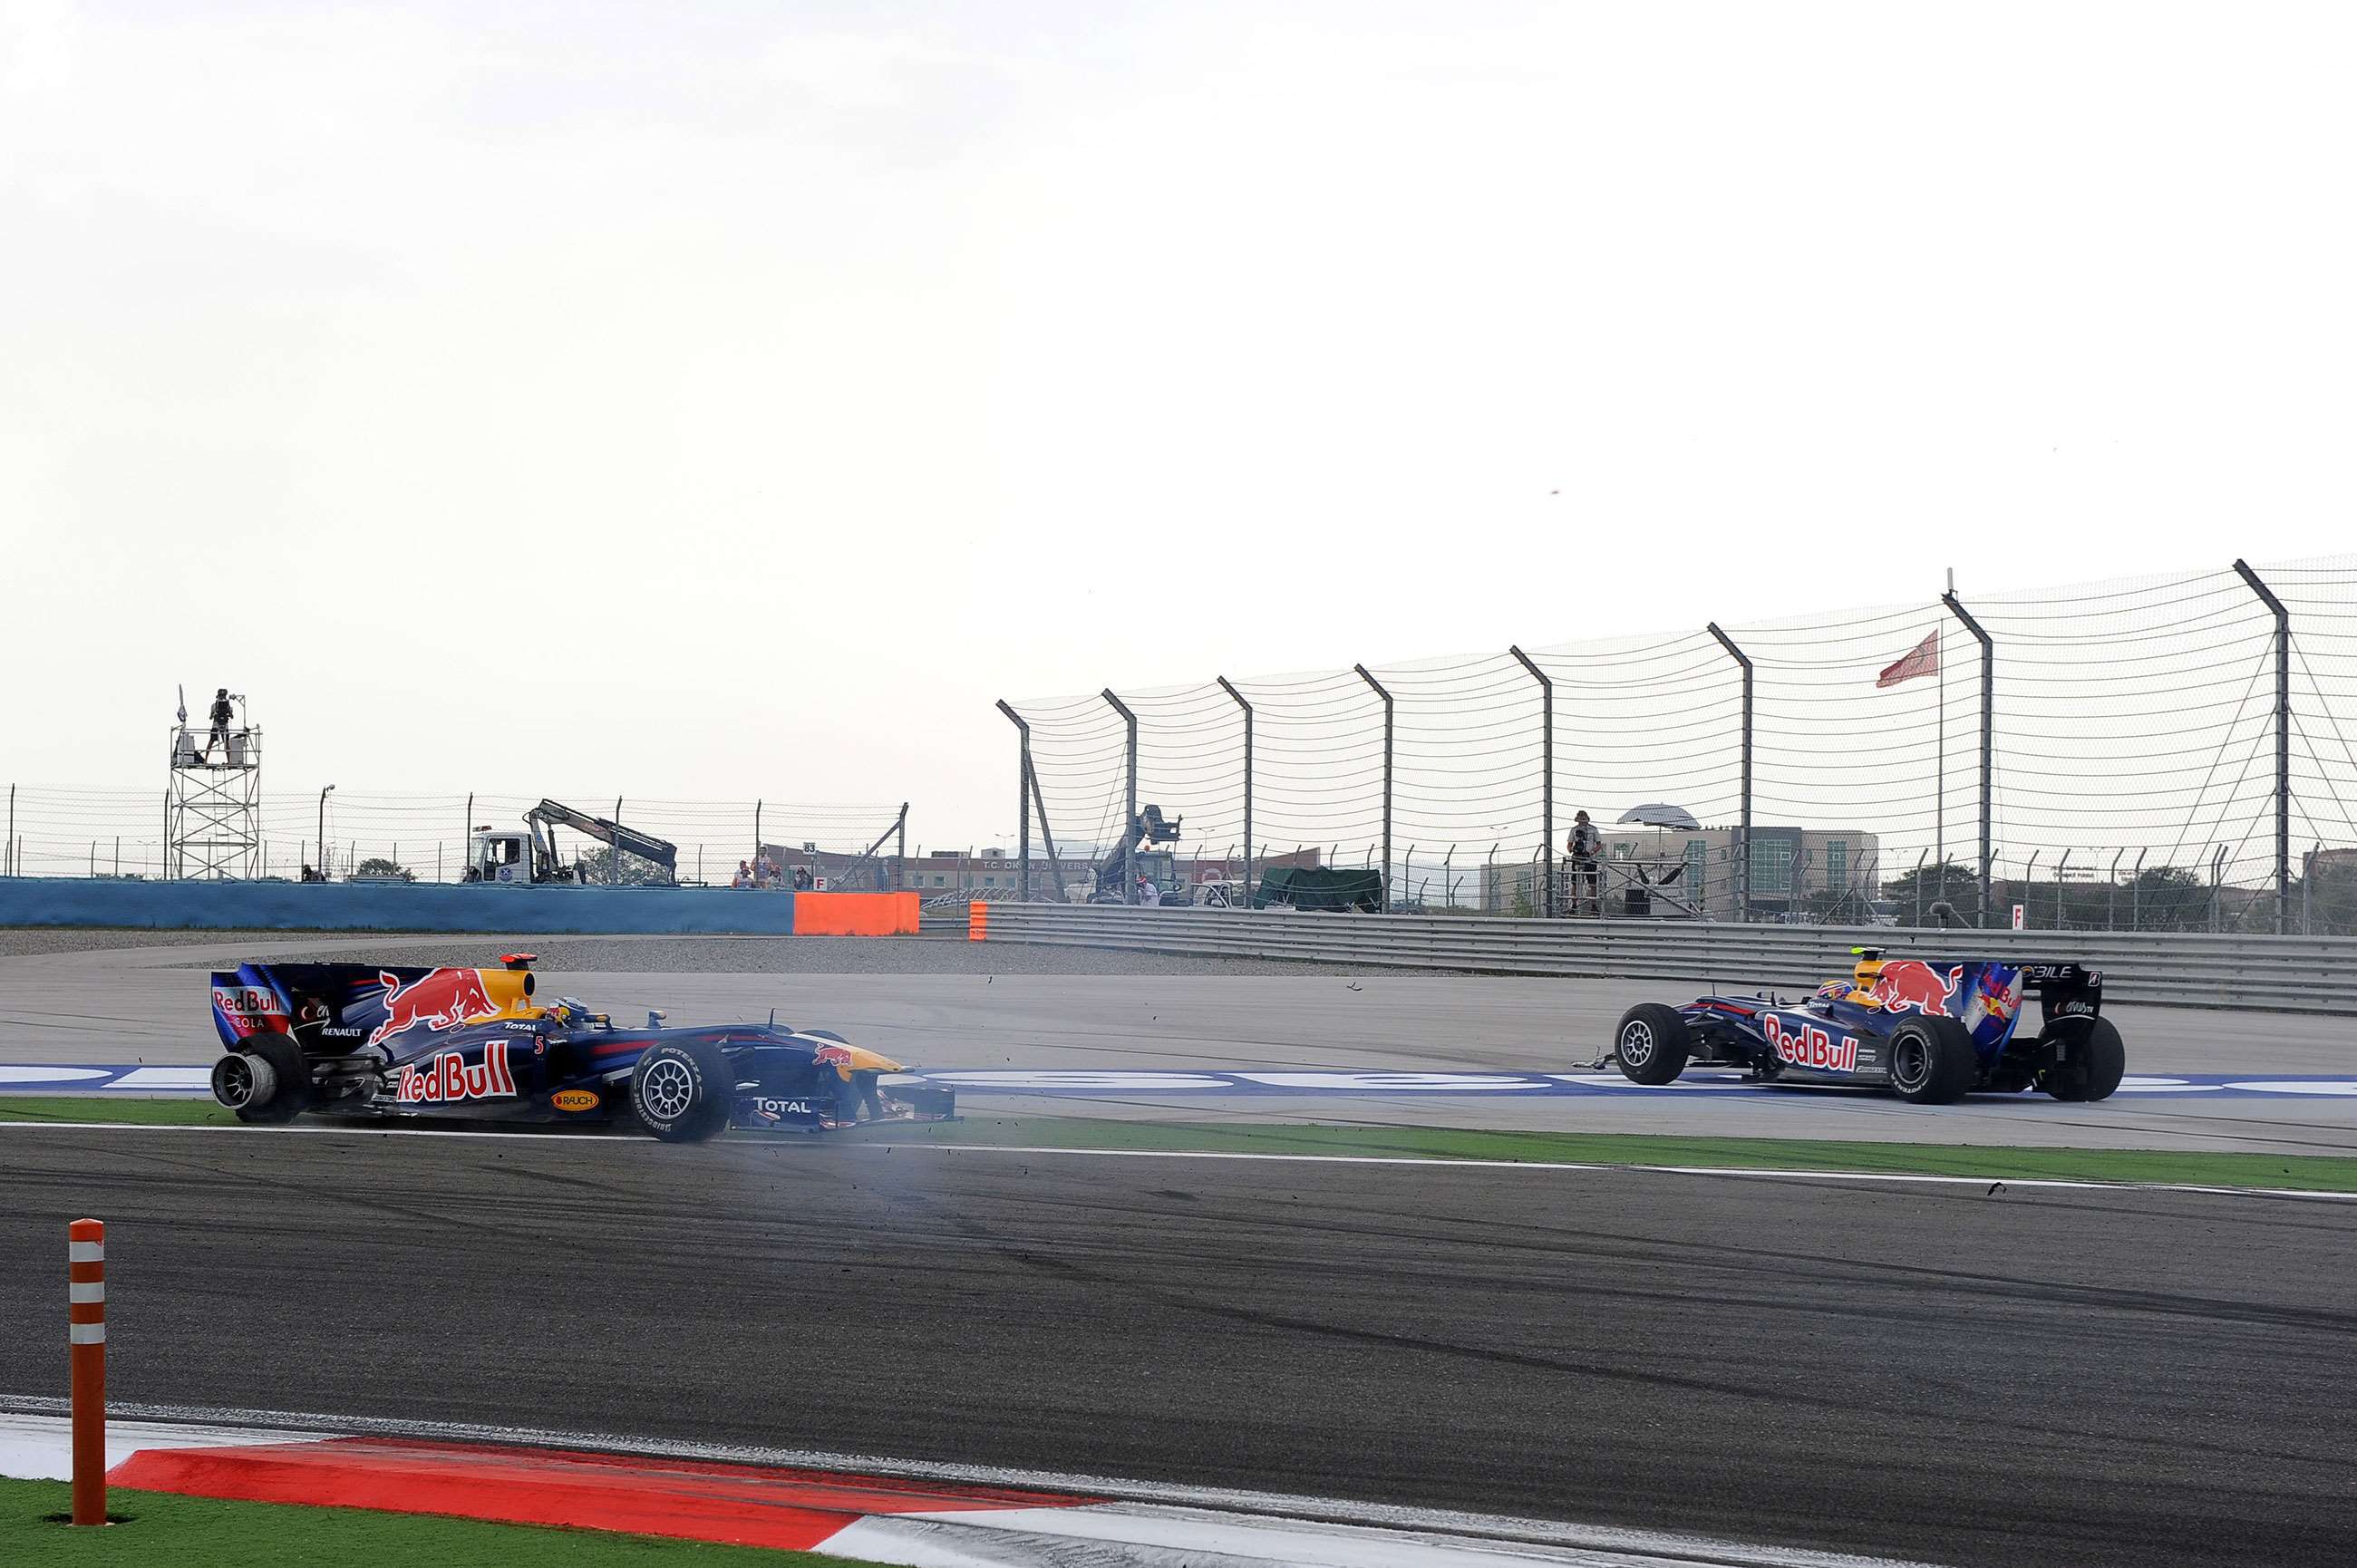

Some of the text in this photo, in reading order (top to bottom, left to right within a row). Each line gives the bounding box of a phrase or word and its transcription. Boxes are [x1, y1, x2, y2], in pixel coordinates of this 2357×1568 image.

[804, 844, 815, 853] 83
[817, 879, 824, 889] F
[2014, 908, 2021, 927] F
[214, 990, 280, 1011] Red Bull
[233, 1017, 265, 1028] COLA
[504, 1021, 537, 1031] TOTAL
[321, 1028, 363, 1037] RENAULT
[534, 1035, 544, 1055] 5
[1764, 1012, 1810, 1067] Red
[1810, 1028, 1859, 1073] Bull
[396, 1040, 518, 1103] Red Bull
[661, 1047, 703, 1083] POTENZA
[563, 1096, 593, 1105] RAUCH
[752, 1097, 812, 1114] TOTAL
